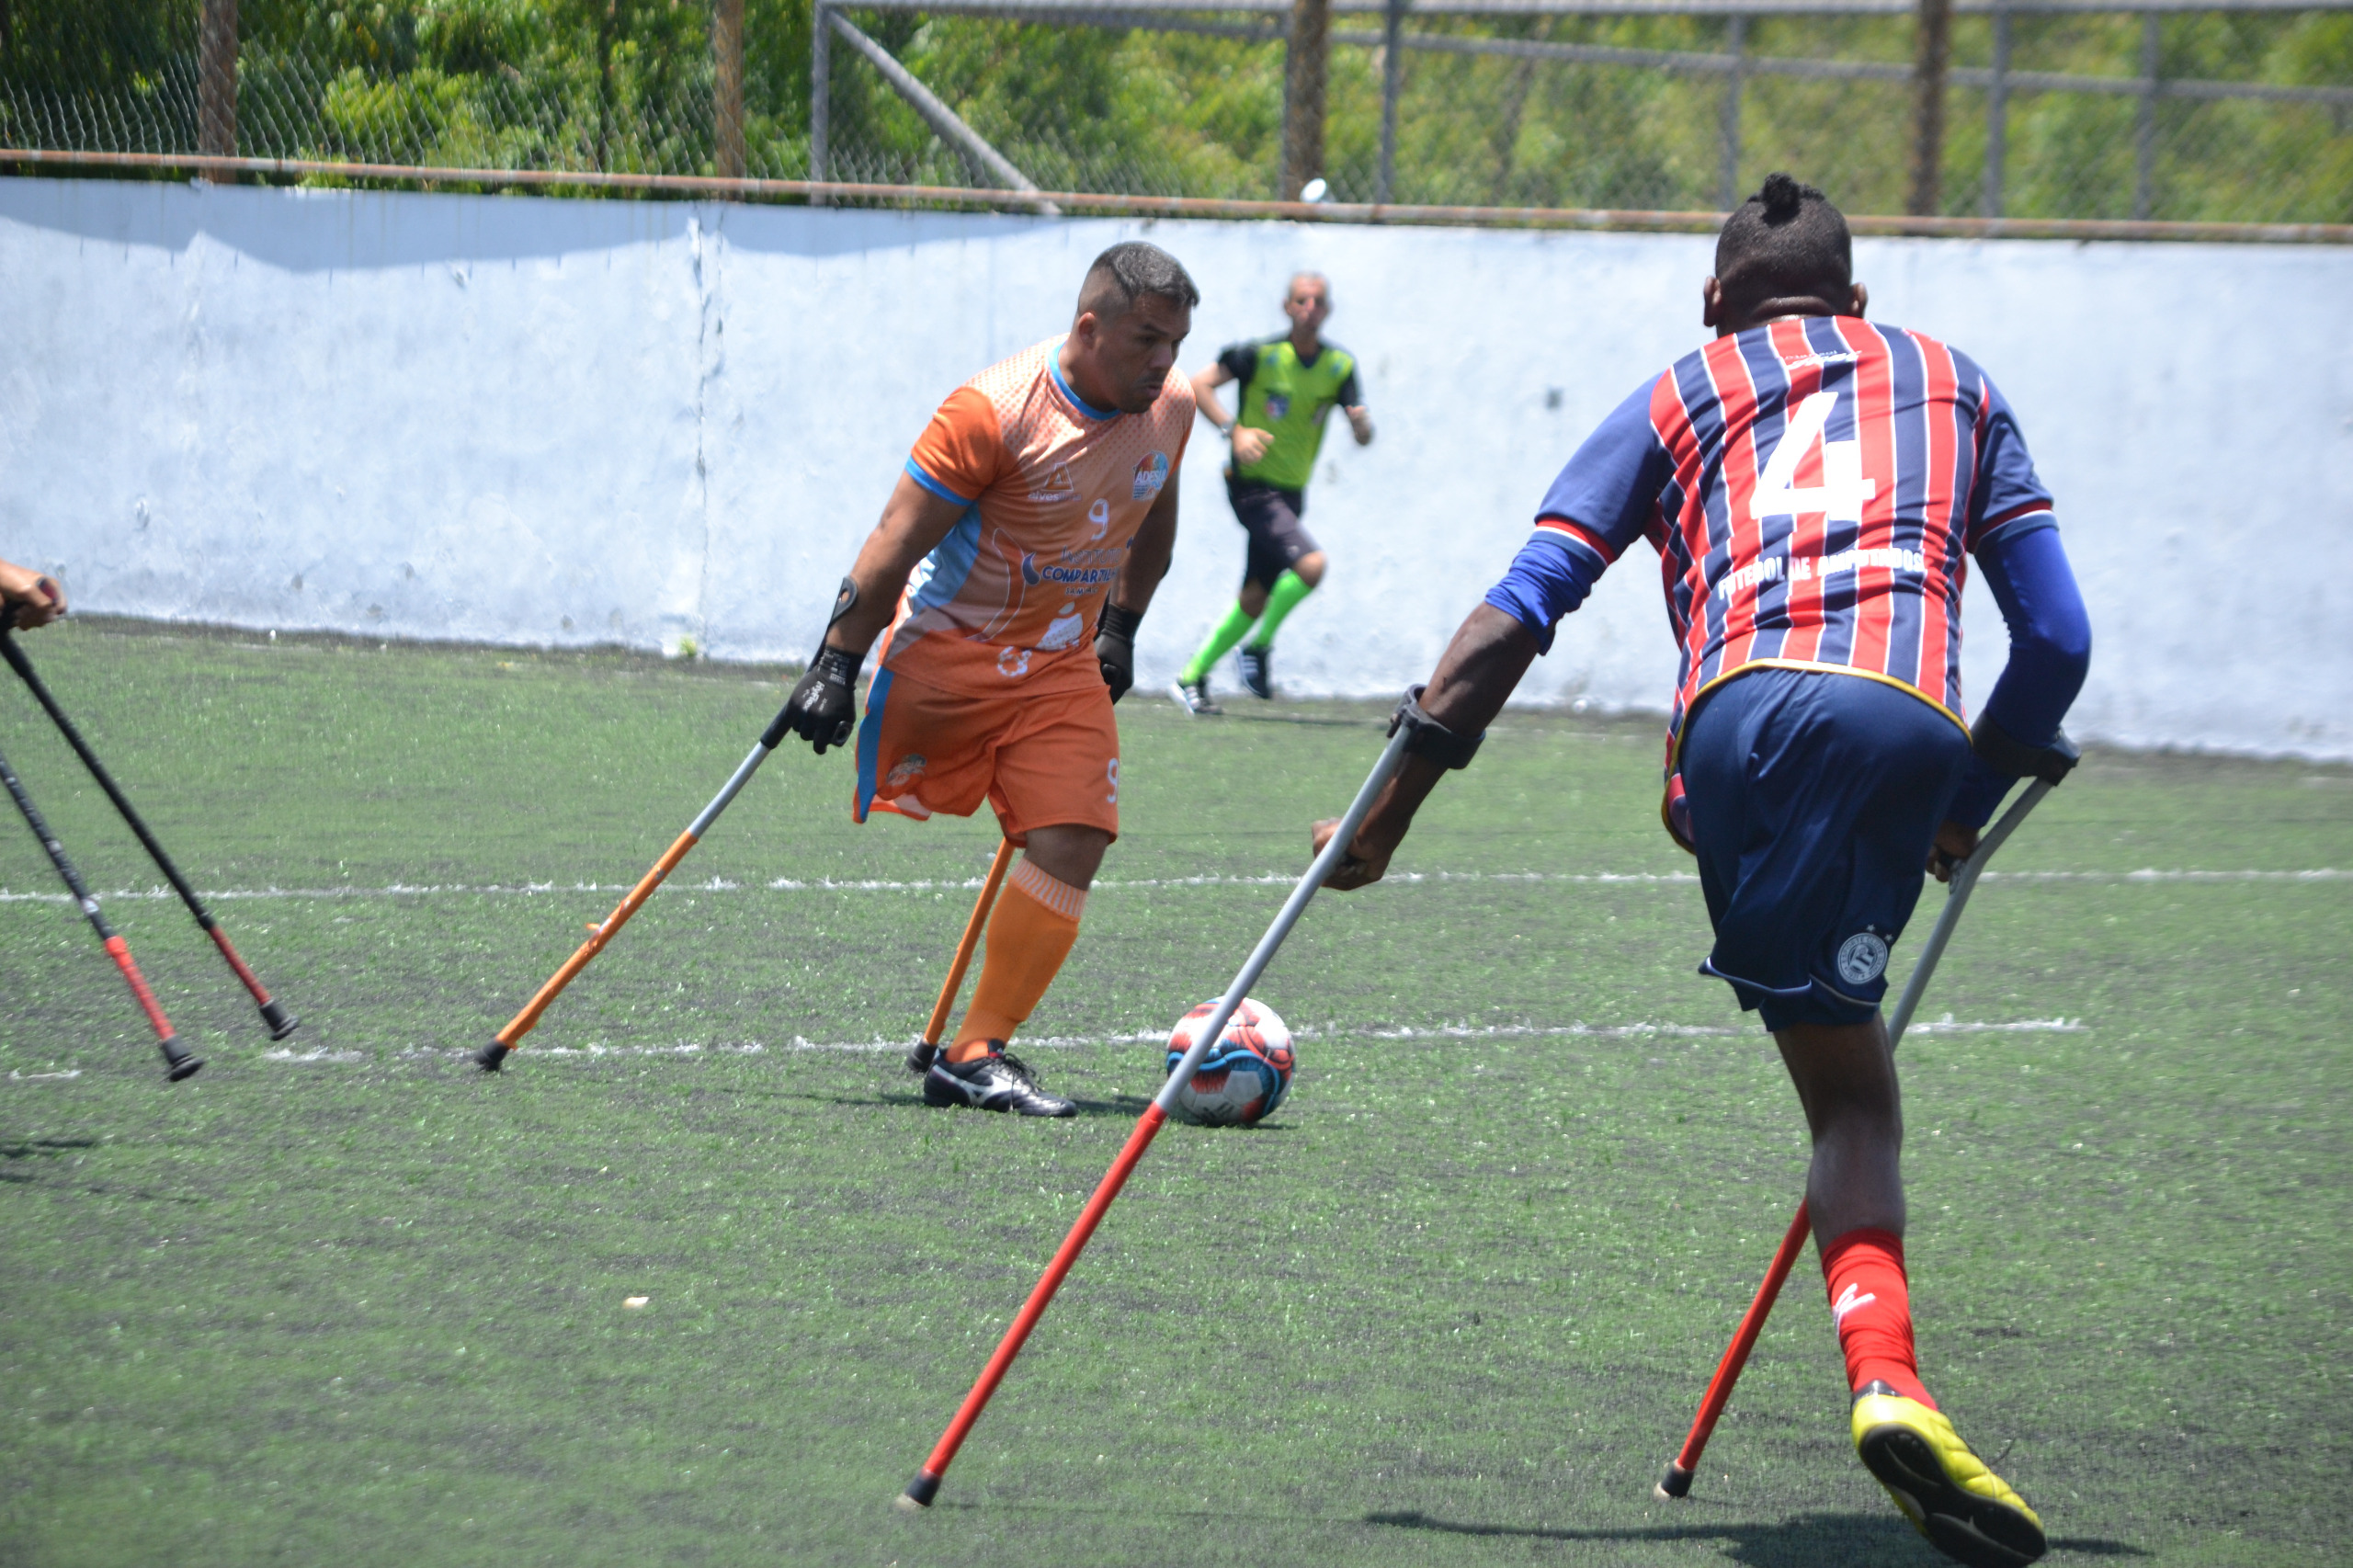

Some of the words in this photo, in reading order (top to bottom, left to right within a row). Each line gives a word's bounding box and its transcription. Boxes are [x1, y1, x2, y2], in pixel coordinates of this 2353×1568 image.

[1749, 392, 1875, 521] 4
[1088, 497, 1110, 540] 9
[1717, 557, 1786, 600] FUTEBOL
[1790, 557, 1811, 581] DE
[1817, 548, 1927, 577] AMPUTADOS
[1107, 757, 1120, 803] 9
